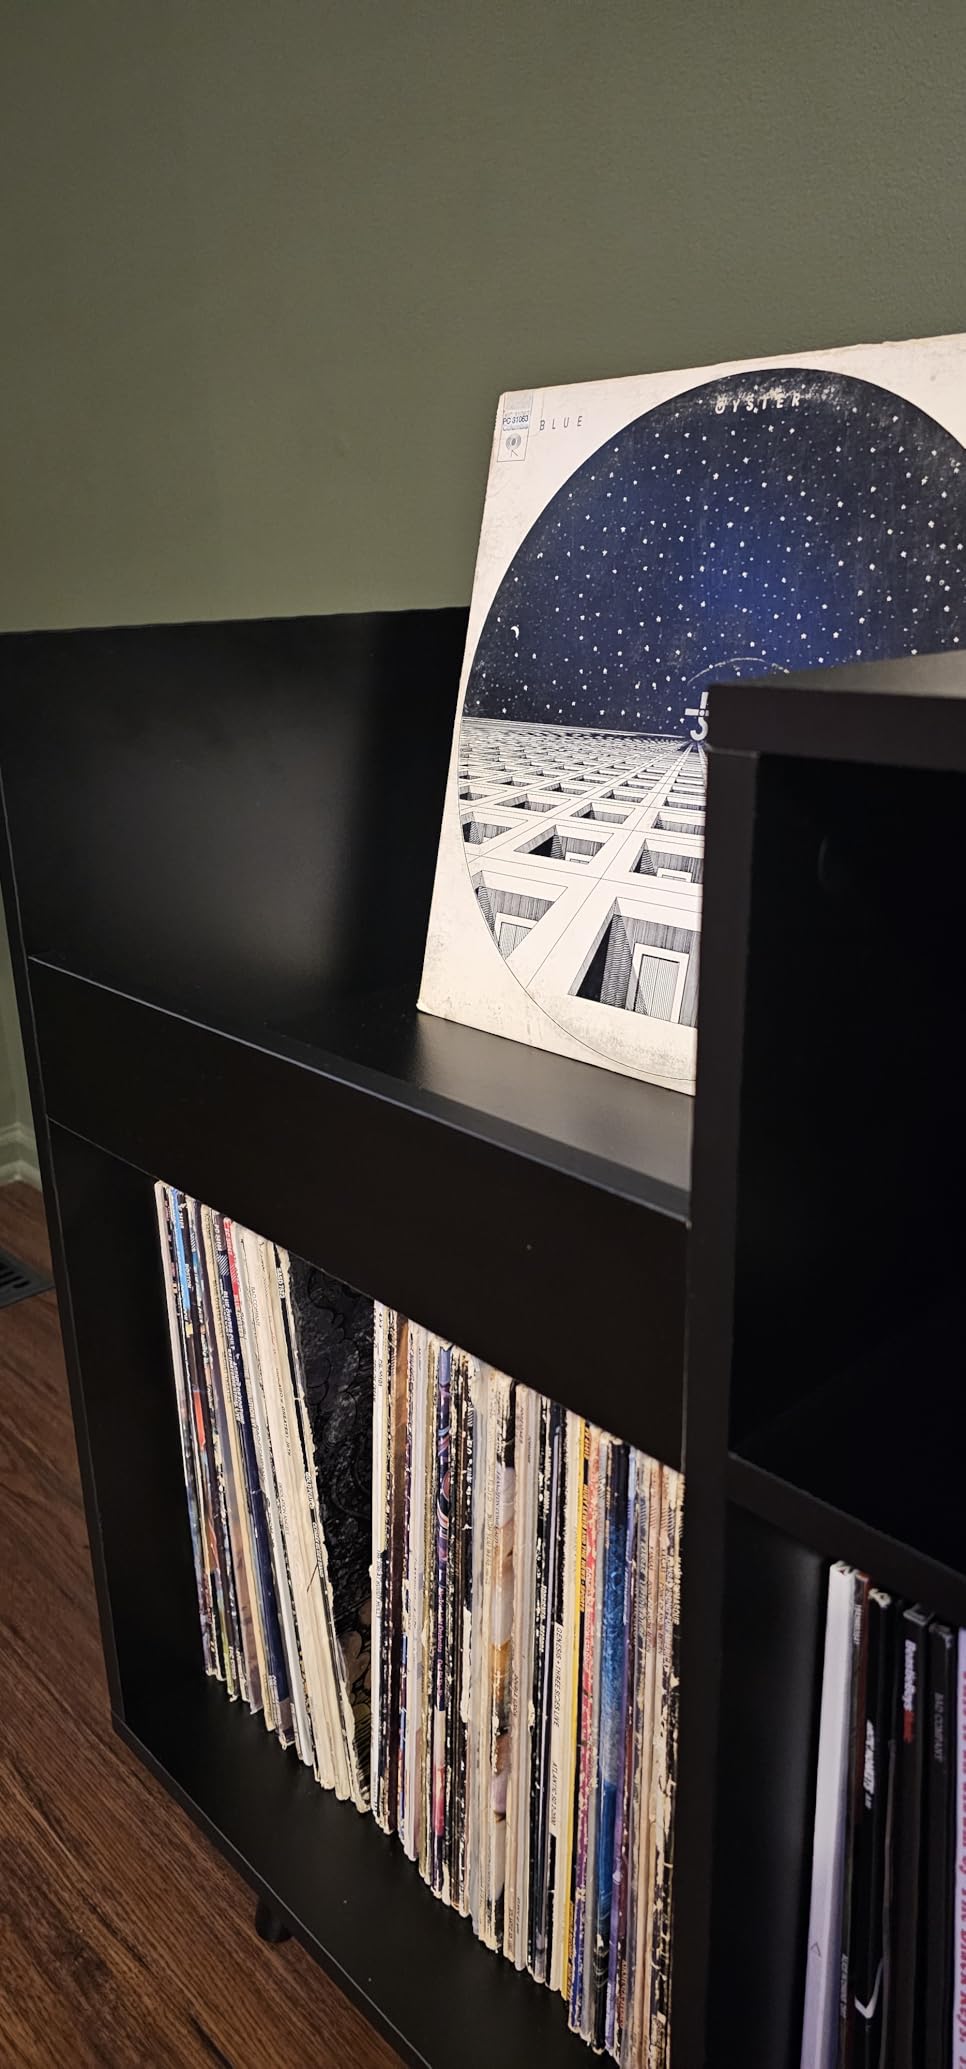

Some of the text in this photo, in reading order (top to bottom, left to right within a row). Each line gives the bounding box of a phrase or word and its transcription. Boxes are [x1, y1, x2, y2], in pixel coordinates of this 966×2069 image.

[539, 416, 583, 431] BLUE
[934, 1692, 944, 1763] BAD COMPANY
